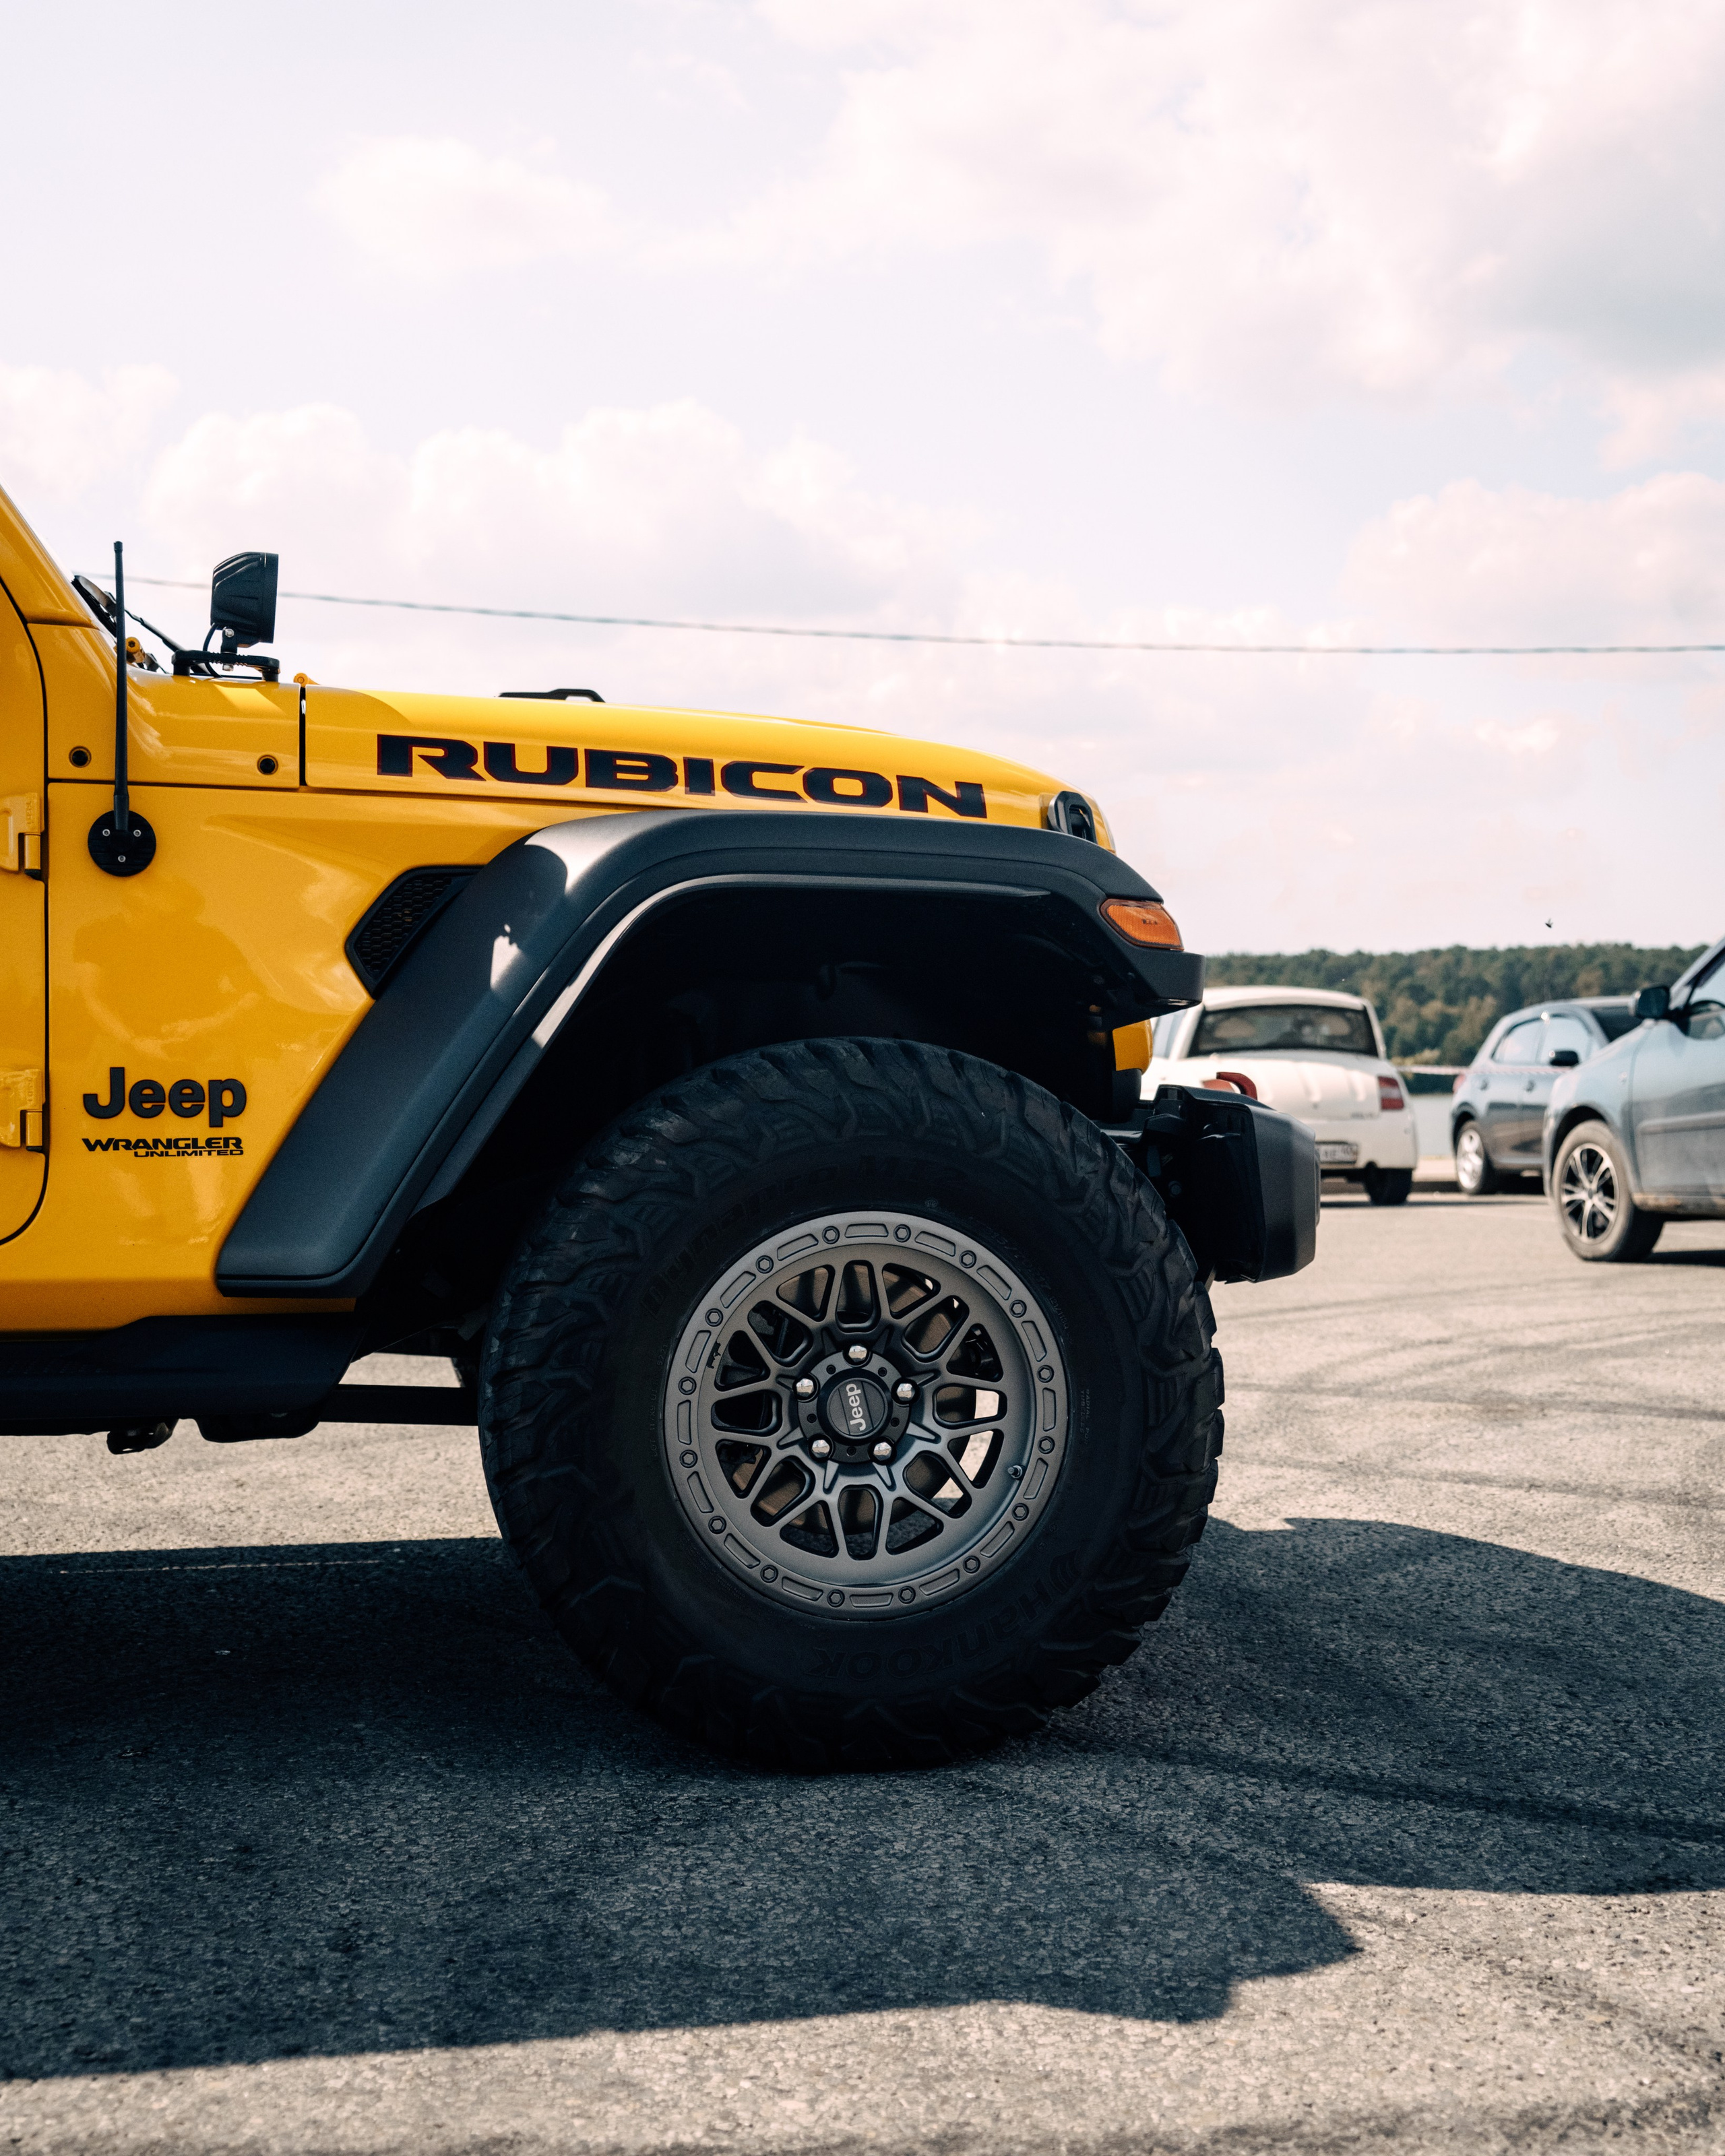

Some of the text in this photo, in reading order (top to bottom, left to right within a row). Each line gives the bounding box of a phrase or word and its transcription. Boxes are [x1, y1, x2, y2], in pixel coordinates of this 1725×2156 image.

[377, 734, 987, 819] RUBICON
[83, 1067, 247, 1127] Jeep
[82, 1137, 243, 1151] WRANGLER
[846, 1383, 867, 1431] Jeep
